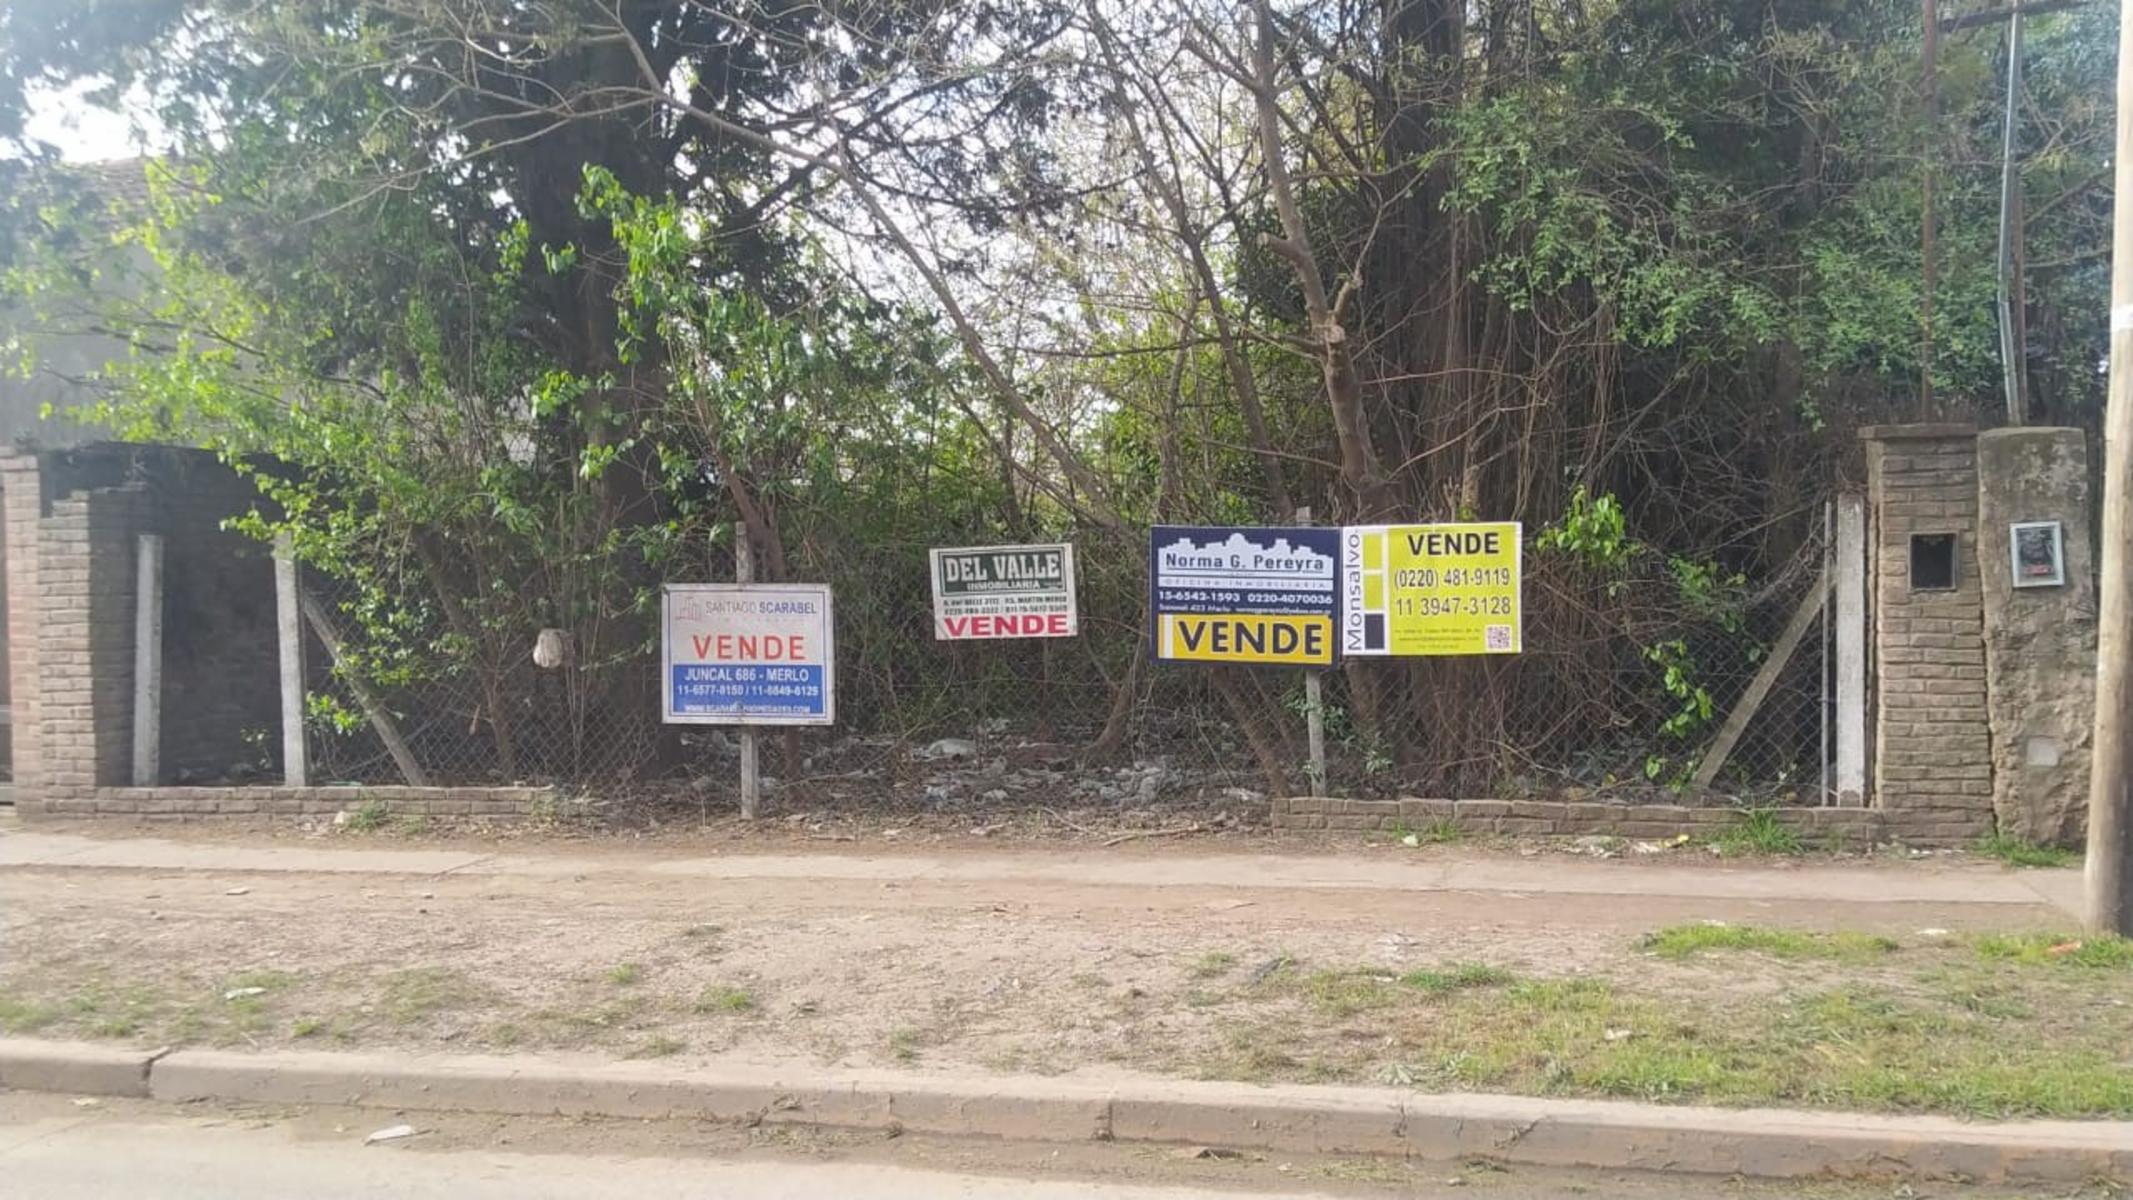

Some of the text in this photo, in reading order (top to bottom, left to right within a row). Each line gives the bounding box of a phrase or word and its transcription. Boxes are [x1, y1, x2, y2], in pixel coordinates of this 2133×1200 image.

[1408, 532, 1500, 556] VENDE
[945, 553, 1061, 582] DEL VALLE
[1166, 553, 1324, 572] Norma G. Pereyra
[1394, 568, 1510, 590] (0220) 481-9119
[1159, 591, 1333, 604] 15-6542-1593 0220-4070036
[1345, 534, 1362, 650] Monsalvo
[705, 601, 817, 614] SANTIAGO SCARABEL
[1396, 597, 1511, 616] 11 3947-3128
[944, 614, 1068, 637] VENDE
[693, 635, 806, 660] VENDE
[1178, 621, 1322, 655] VENDE
[685, 669, 732, 681] JUNCAL
[735, 669, 757, 681] 686
[766, 669, 809, 681] MERLO
